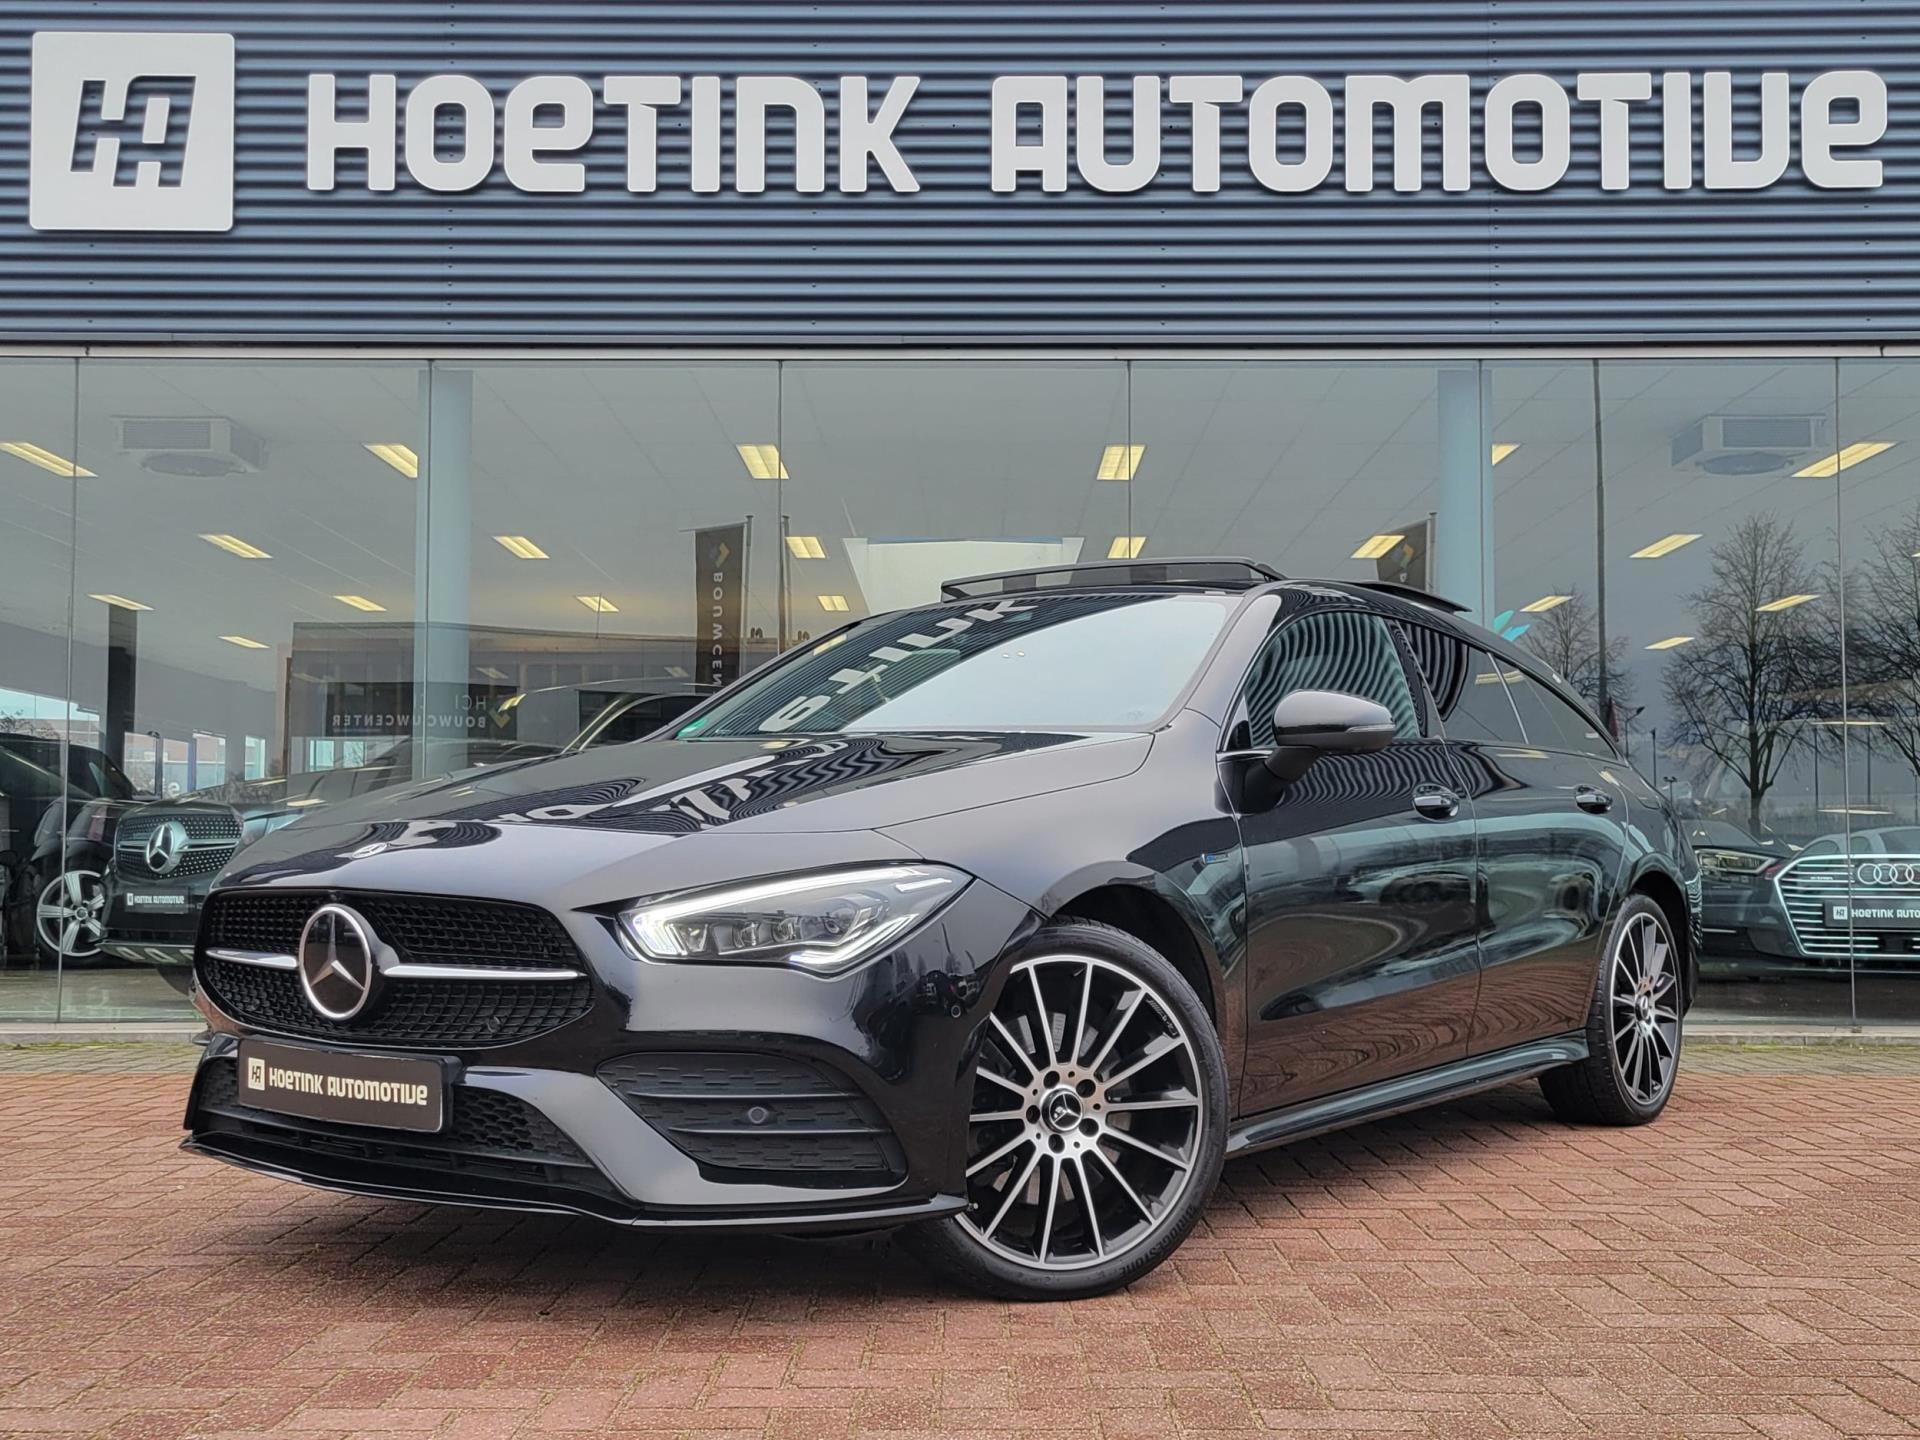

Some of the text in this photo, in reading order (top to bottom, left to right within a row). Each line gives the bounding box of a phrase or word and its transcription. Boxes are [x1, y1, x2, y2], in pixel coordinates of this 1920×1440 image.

[307, 70, 1889, 193] HOETINK AUTOMOTIVE
[1851, 908, 1894, 918] HOETINK
[269, 1067, 428, 1106] HOETINK AUTOMOTIVE
